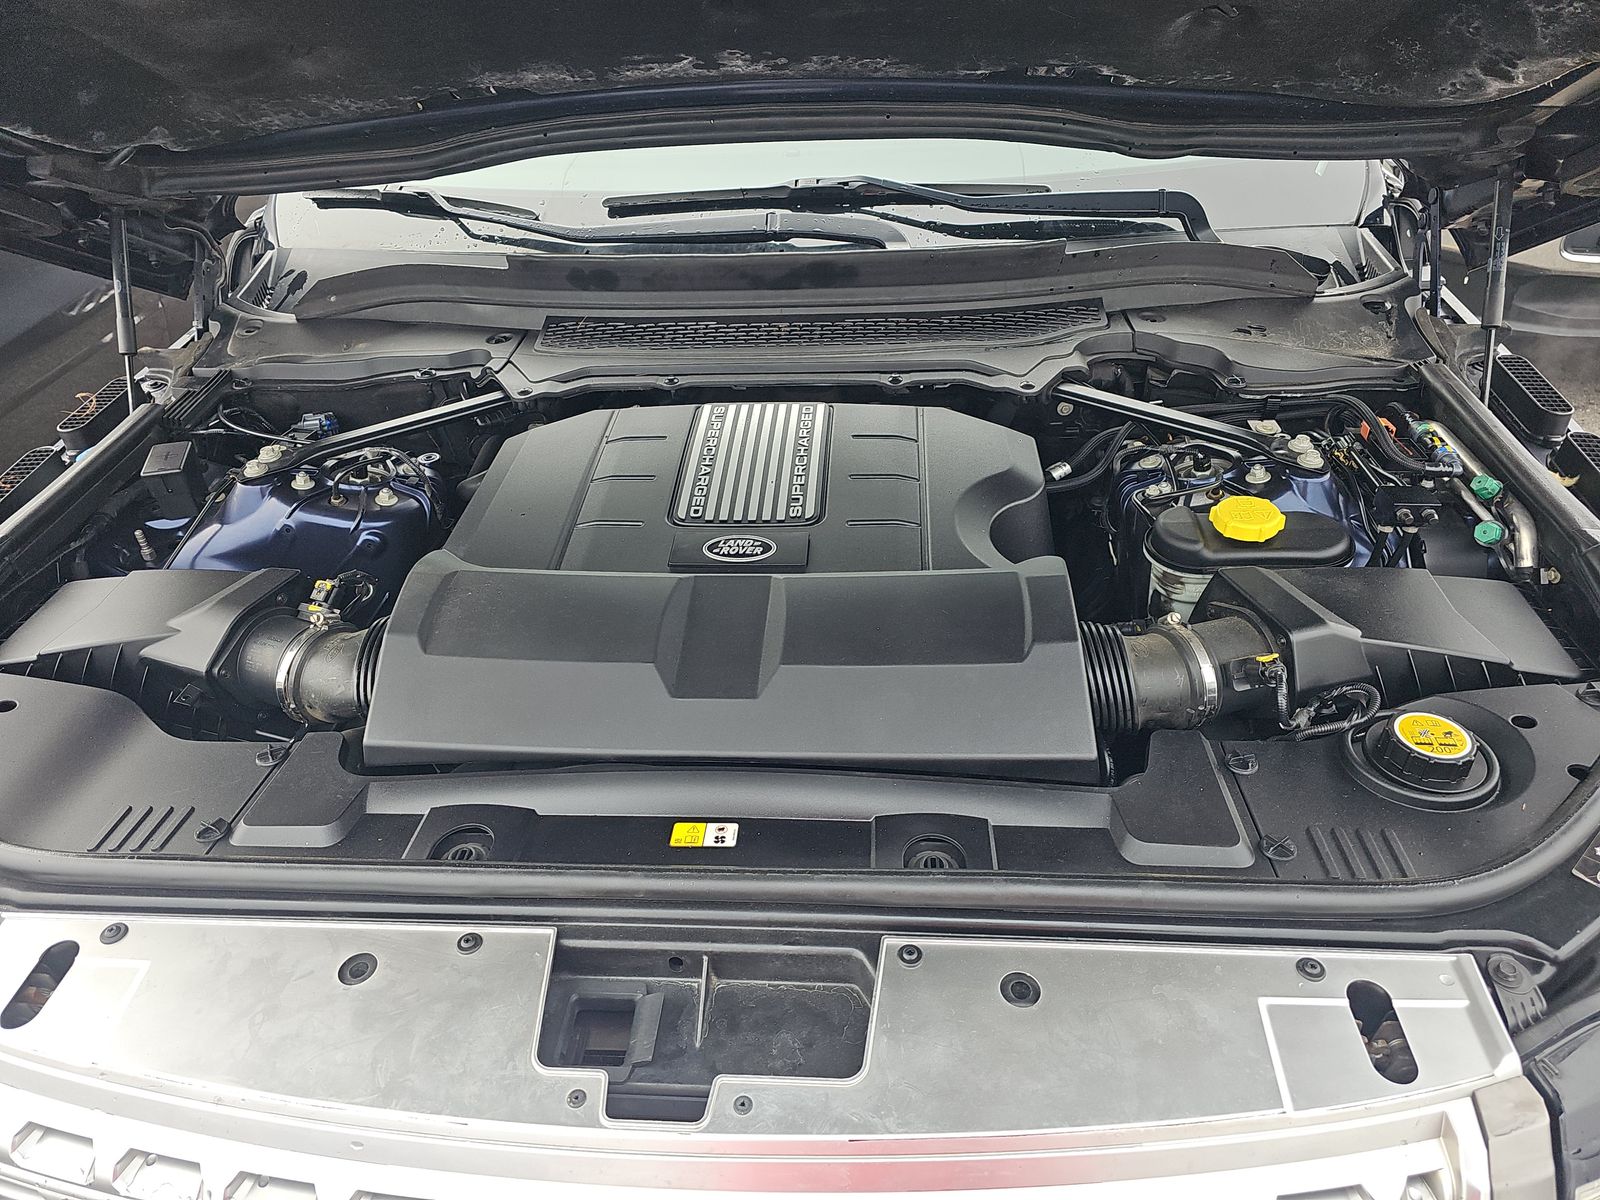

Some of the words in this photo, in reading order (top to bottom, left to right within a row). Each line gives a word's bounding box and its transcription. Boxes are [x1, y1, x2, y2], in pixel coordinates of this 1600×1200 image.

[690, 406, 725, 518] SUPERCHARGED
[789, 405, 813, 518] SUPERCHARGED
[718, 539, 753, 547] LAND
[719, 546, 763, 555] ROVER
